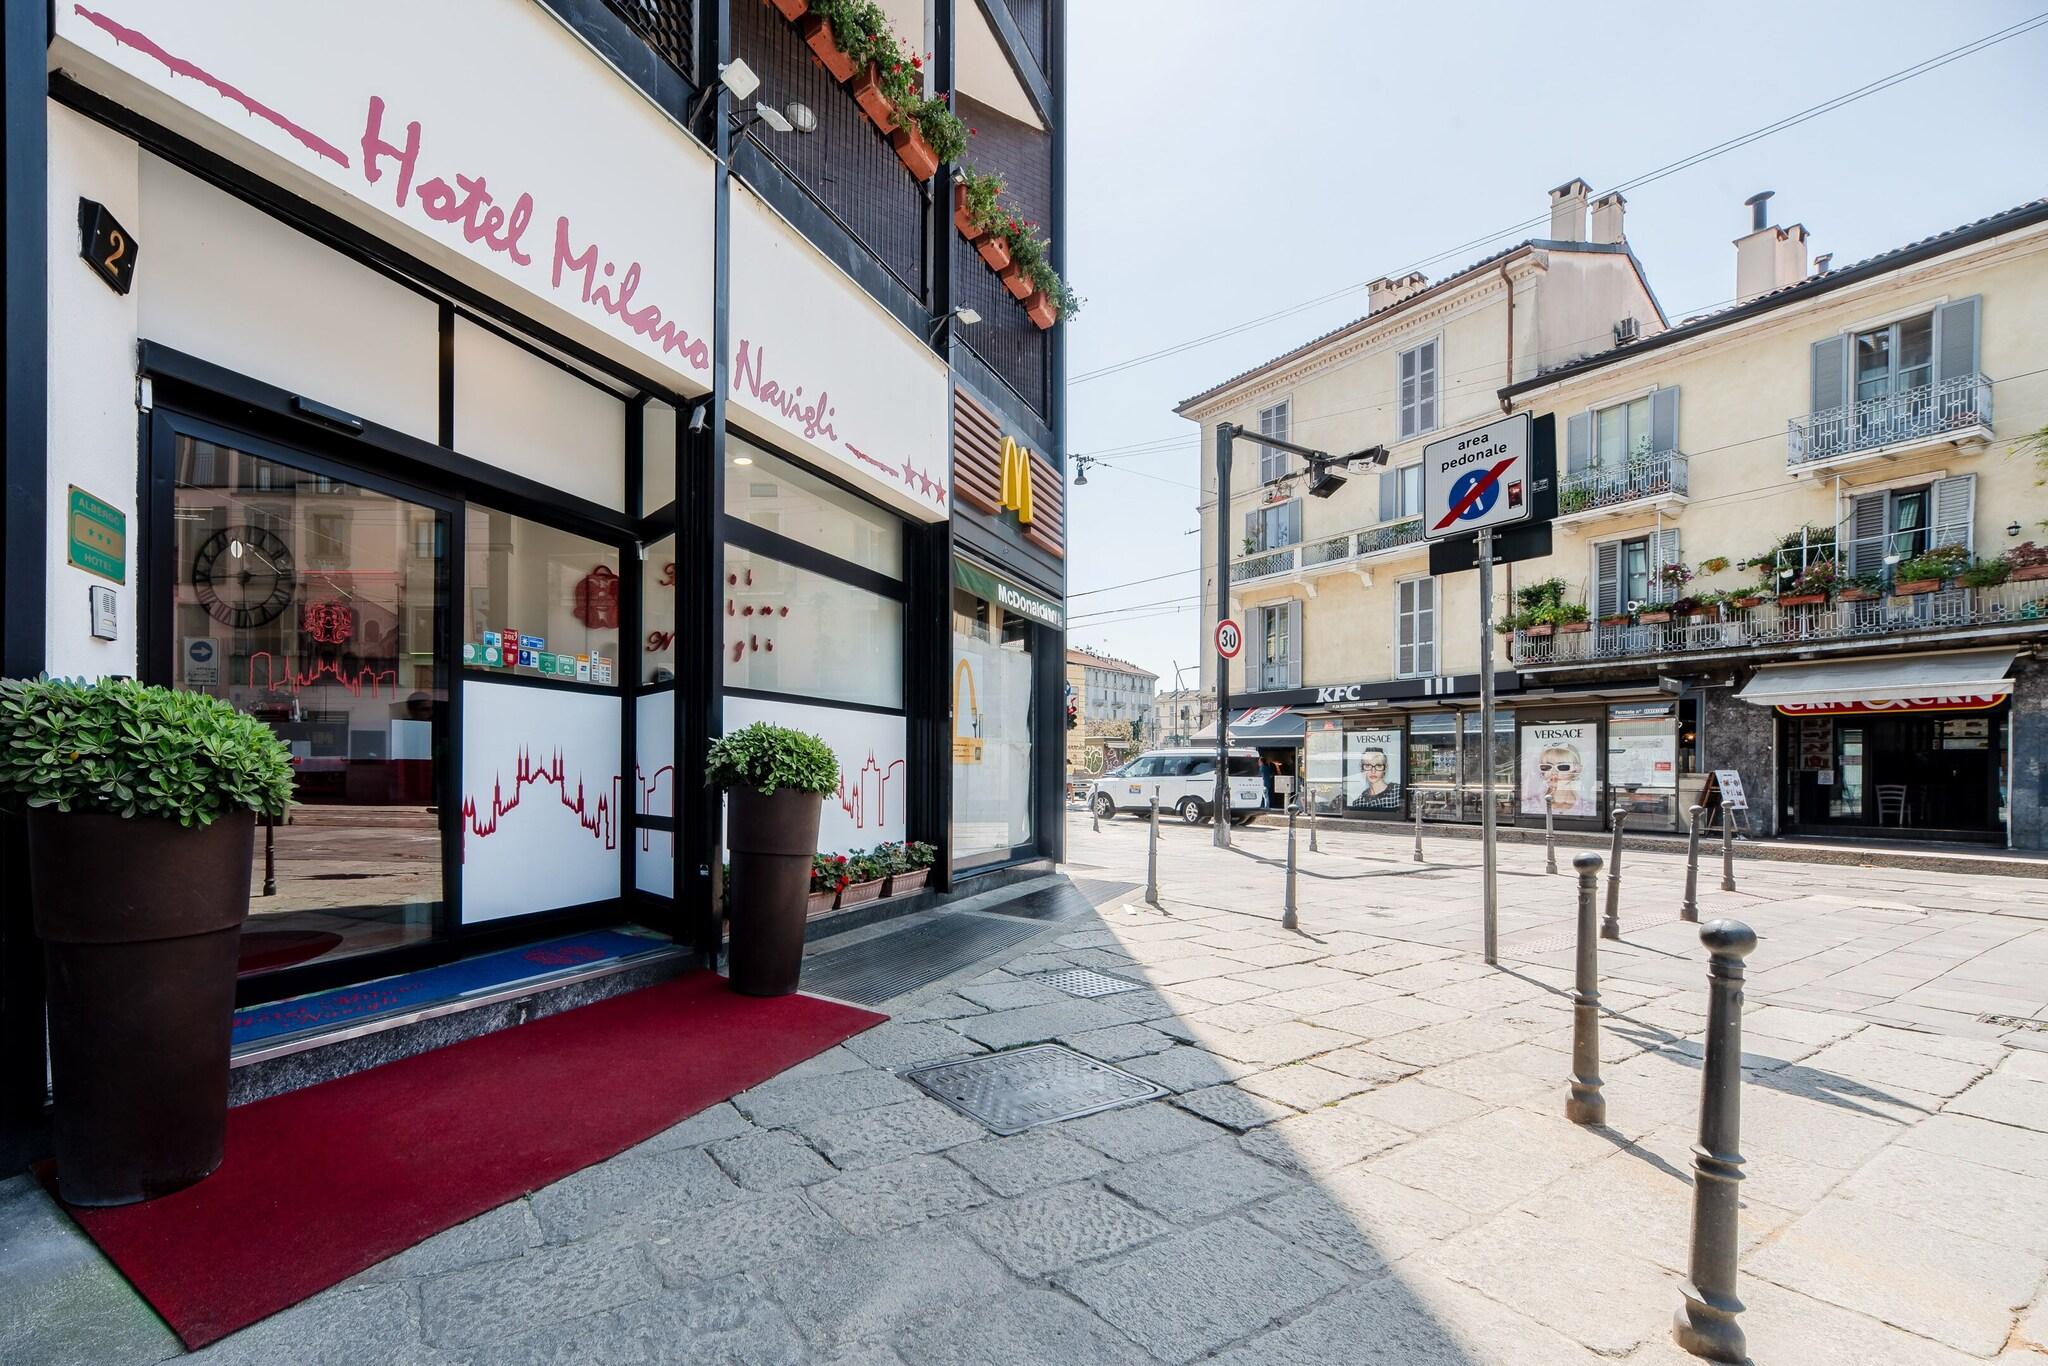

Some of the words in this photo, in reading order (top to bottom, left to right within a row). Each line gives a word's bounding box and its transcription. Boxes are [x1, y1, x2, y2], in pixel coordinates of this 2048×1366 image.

[105, 230, 125, 277] 2
[361, 95, 532, 267] Hotel
[552, 216, 710, 370] Milano
[733, 339, 838, 441] Navigli
[1458, 433, 1489, 450] area
[1441, 443, 1507, 473] pedonale
[84, 552, 113, 572] HOTEL
[1221, 629, 1237, 649] 30
[1316, 685, 1361, 703] KFC
[1356, 734, 1391, 744] VERSACE
[1534, 728, 1584, 739] VERSACE
